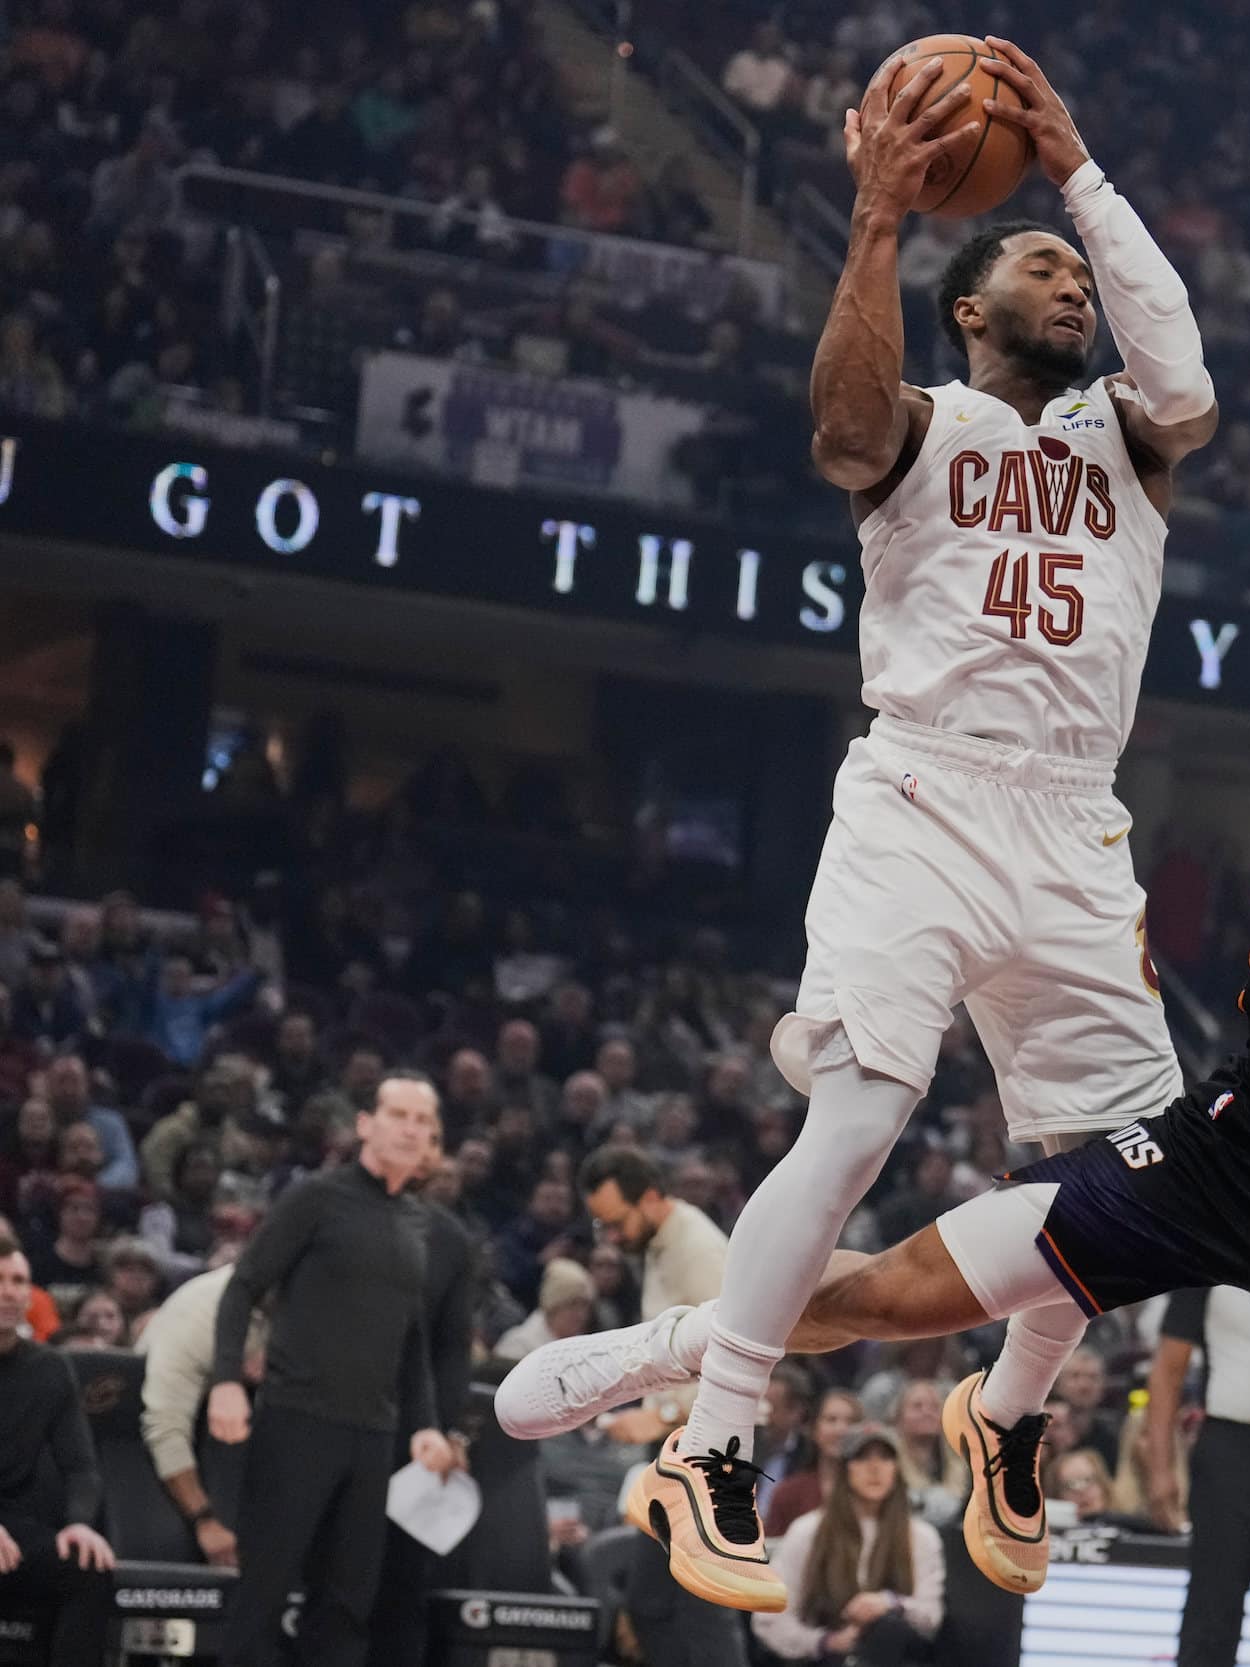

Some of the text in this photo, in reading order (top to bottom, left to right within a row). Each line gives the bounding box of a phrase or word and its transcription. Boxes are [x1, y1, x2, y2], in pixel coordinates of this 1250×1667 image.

[1062, 418, 1106, 432] LIFFS
[949, 437, 1116, 541] CAVS
[149, 460, 421, 568] GOT
[540, 519, 847, 633] THIS
[982, 548, 1084, 647] 45
[114, 1587, 223, 1609] GATORADE
